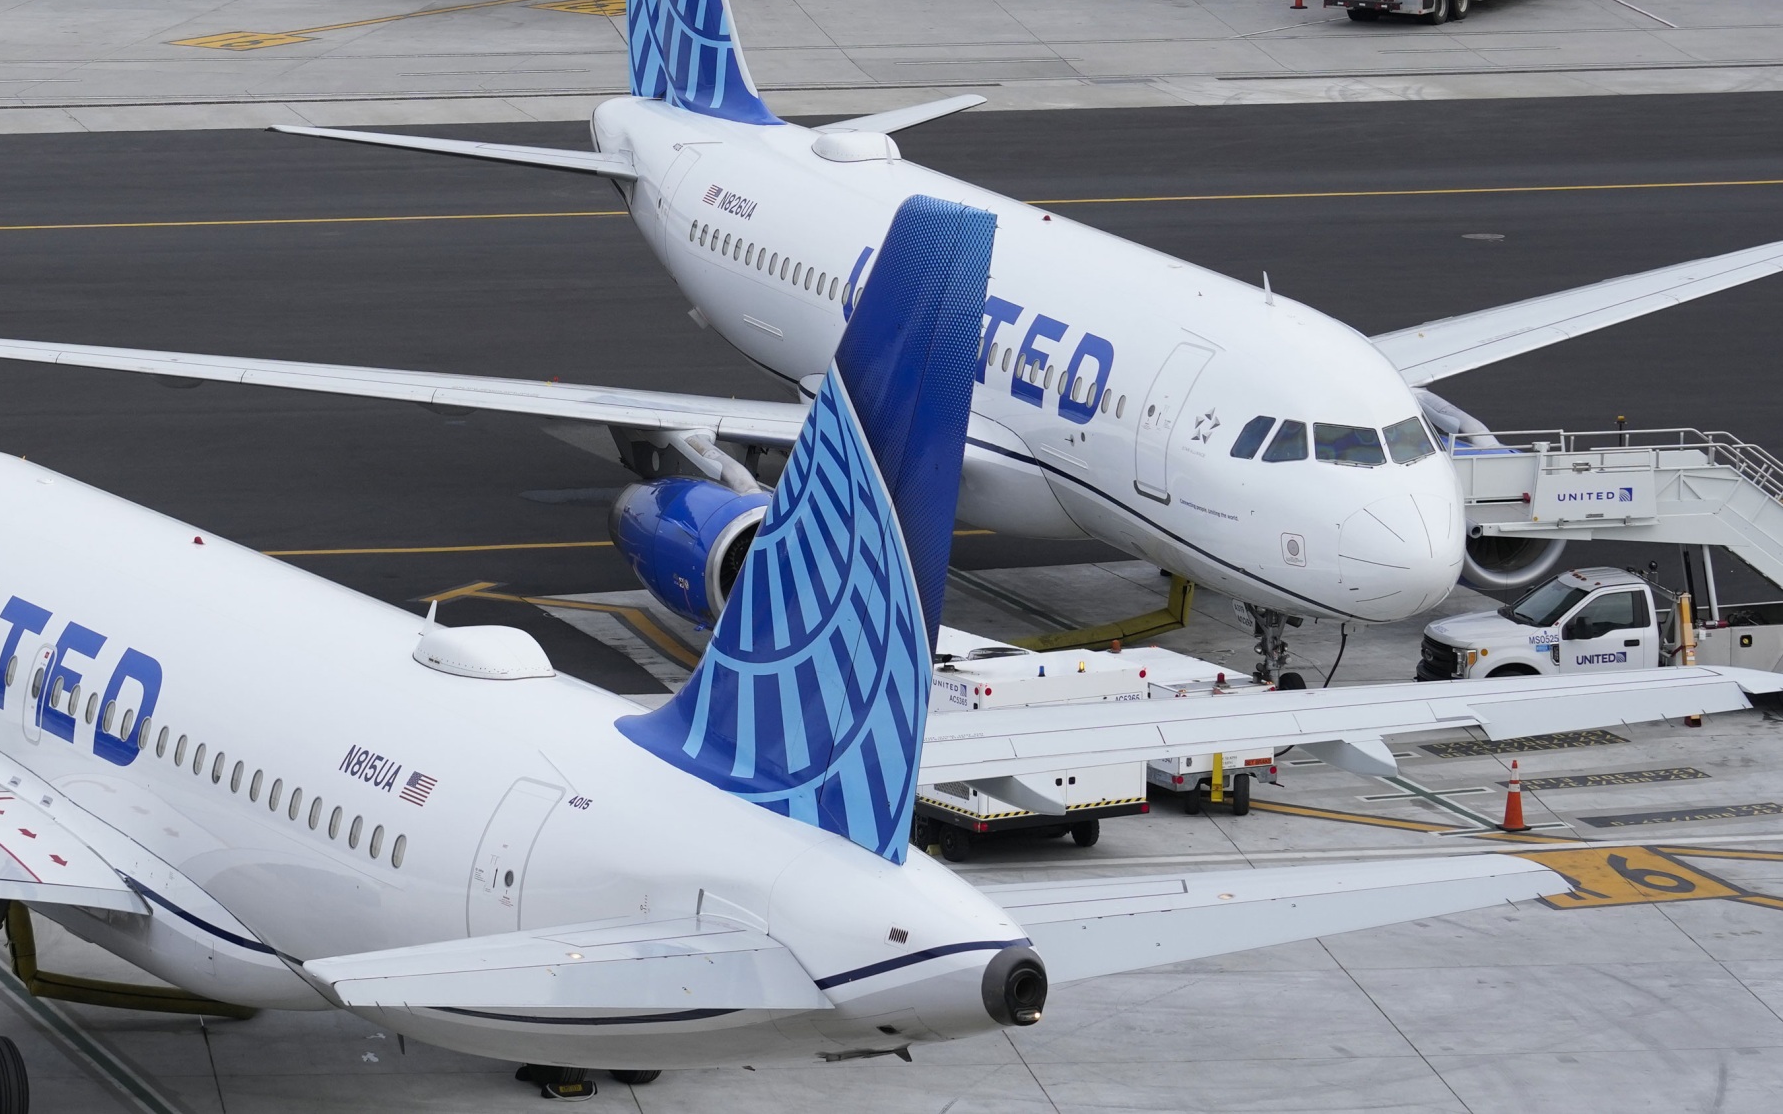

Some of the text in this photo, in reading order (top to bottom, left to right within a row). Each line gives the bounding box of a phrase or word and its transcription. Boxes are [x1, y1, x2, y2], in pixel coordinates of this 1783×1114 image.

[717, 190, 758, 221] N826UA
[1557, 490, 1615, 503] UNITED
[1528, 634, 1560, 645] MS0525
[1576, 652, 1616, 665] UNITED
[932, 679, 959, 692] UNITED
[949, 694, 968, 707] AC5365
[338, 743, 404, 794] N815UA
[568, 795, 593, 810] 4015
